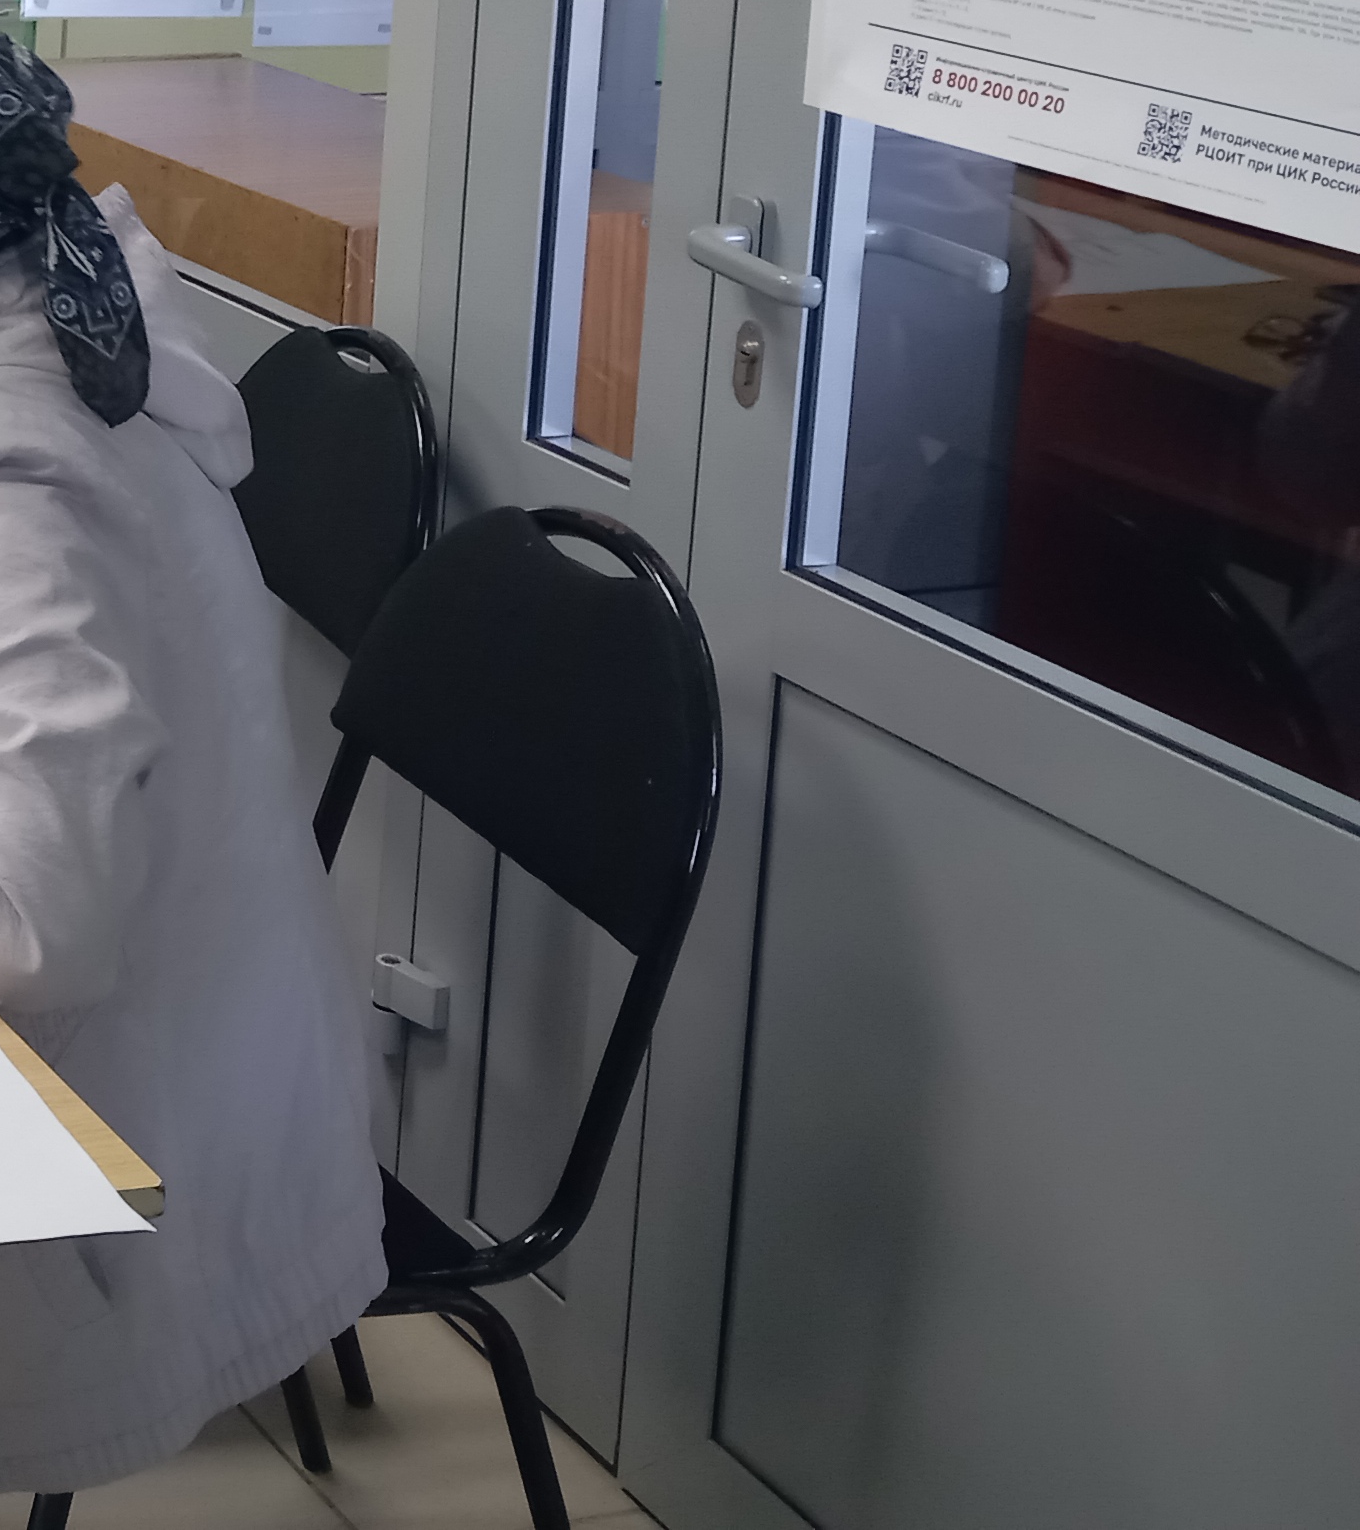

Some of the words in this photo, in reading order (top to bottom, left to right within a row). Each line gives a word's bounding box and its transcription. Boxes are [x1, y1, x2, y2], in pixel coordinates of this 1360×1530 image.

[927, 91, 963, 108] cikrf.ru
[932, 68, 943, 84] 8
[947, 72, 978, 93] 800
[981, 80, 1013, 101] 200
[1017, 89, 1039, 108] 00
[1042, 95, 1065, 114] 20
[1200, 125, 1300, 159] Методические
[1195, 143, 1246, 166] РЦОИТ
[1247, 158, 1273, 173] при
[1276, 163, 1309, 182] ЦИК
